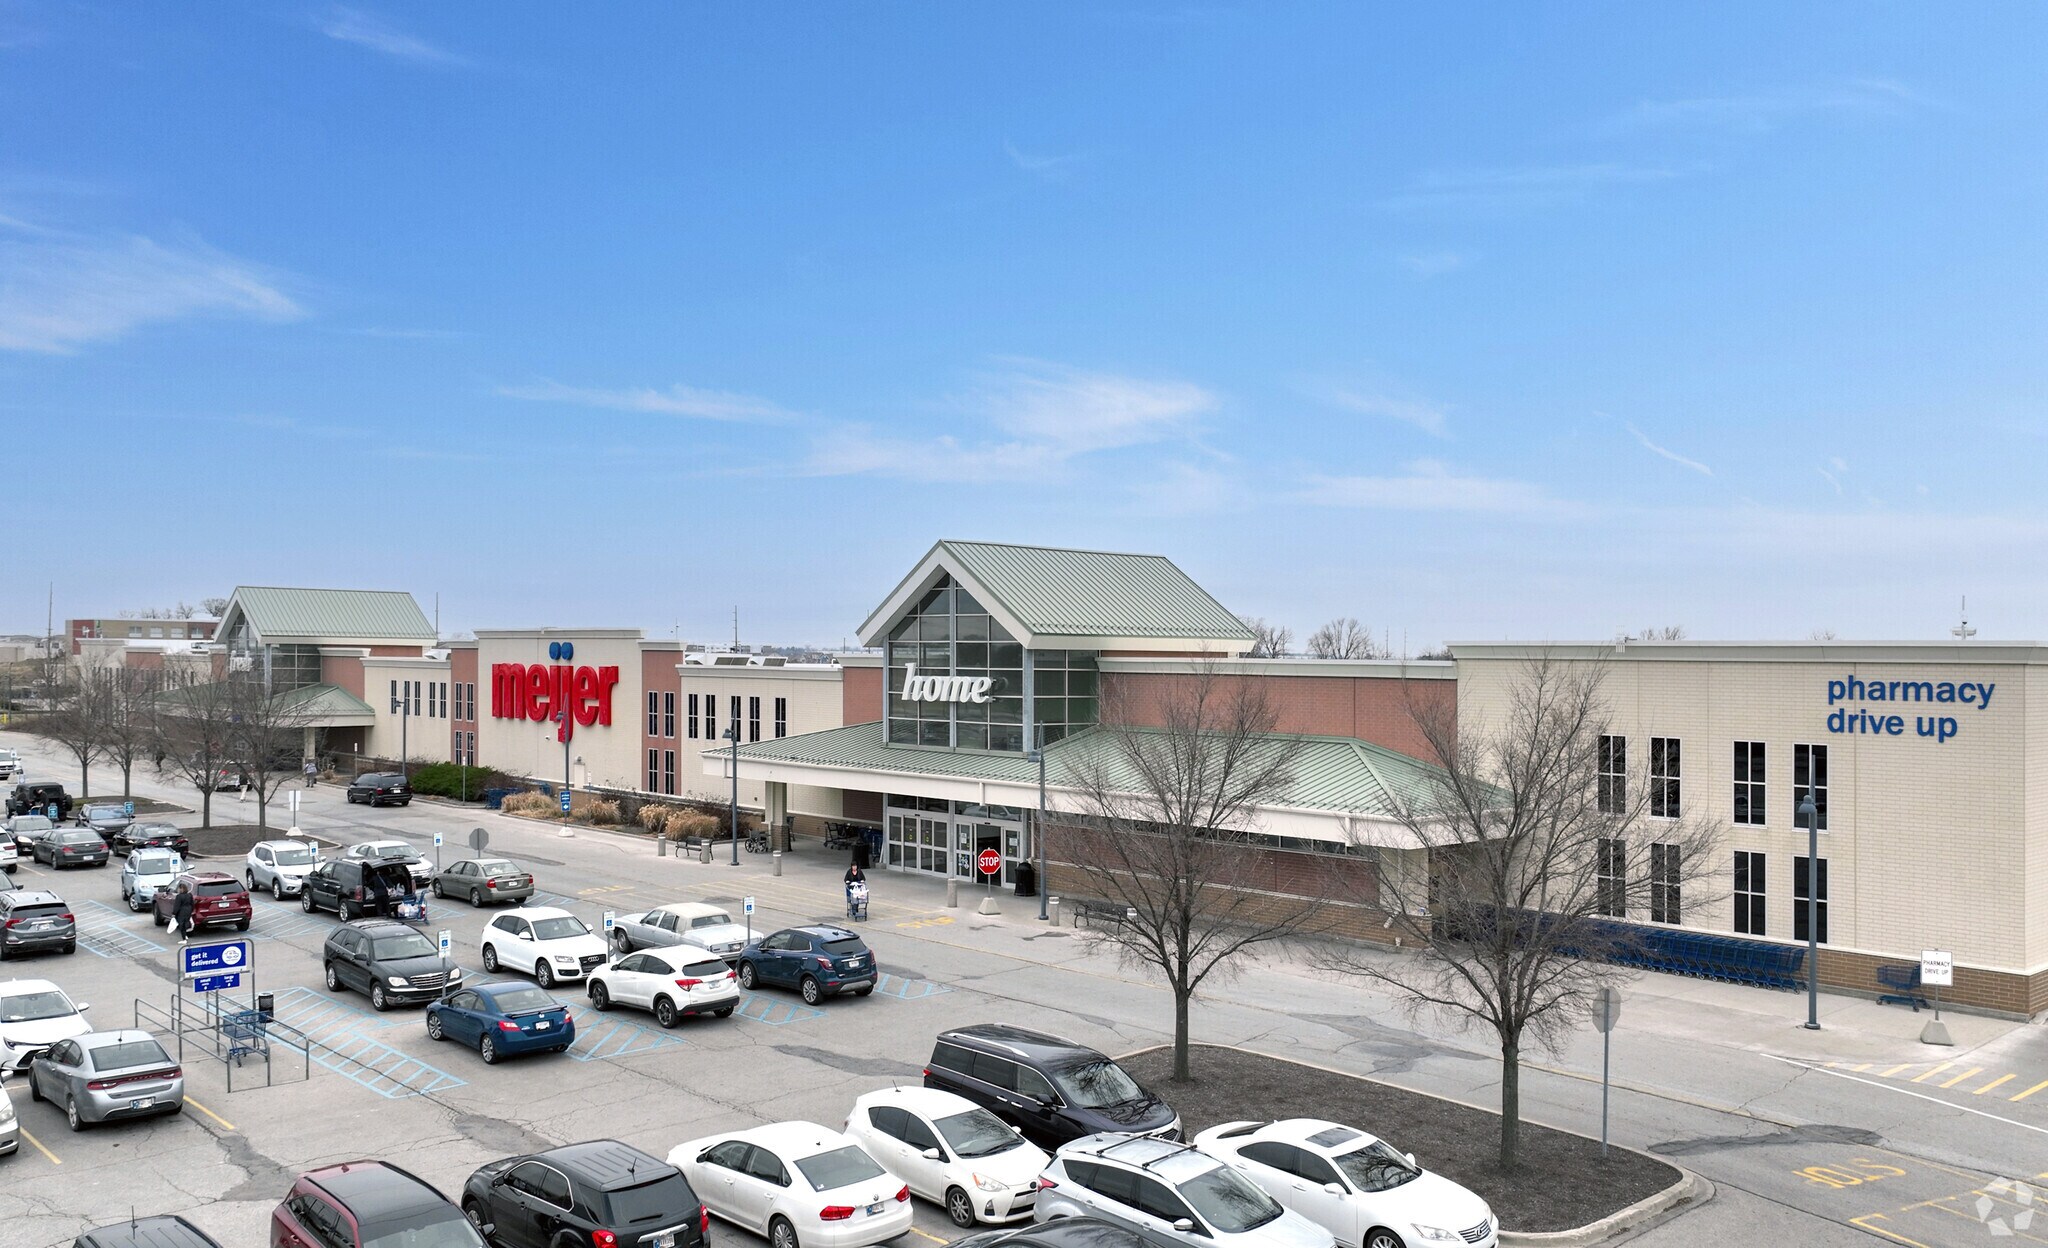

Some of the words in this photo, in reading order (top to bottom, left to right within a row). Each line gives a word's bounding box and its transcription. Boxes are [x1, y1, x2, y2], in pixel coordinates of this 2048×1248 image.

[492, 642, 619, 743] meijer
[901, 662, 992, 704] home
[1828, 675, 1996, 710] pharmacy
[1827, 708, 1904, 735] drive
[1916, 716, 1958, 743] up
[980, 856, 999, 867] STOP
[191, 953, 201, 961] get
[191, 958, 219, 967] delivered
